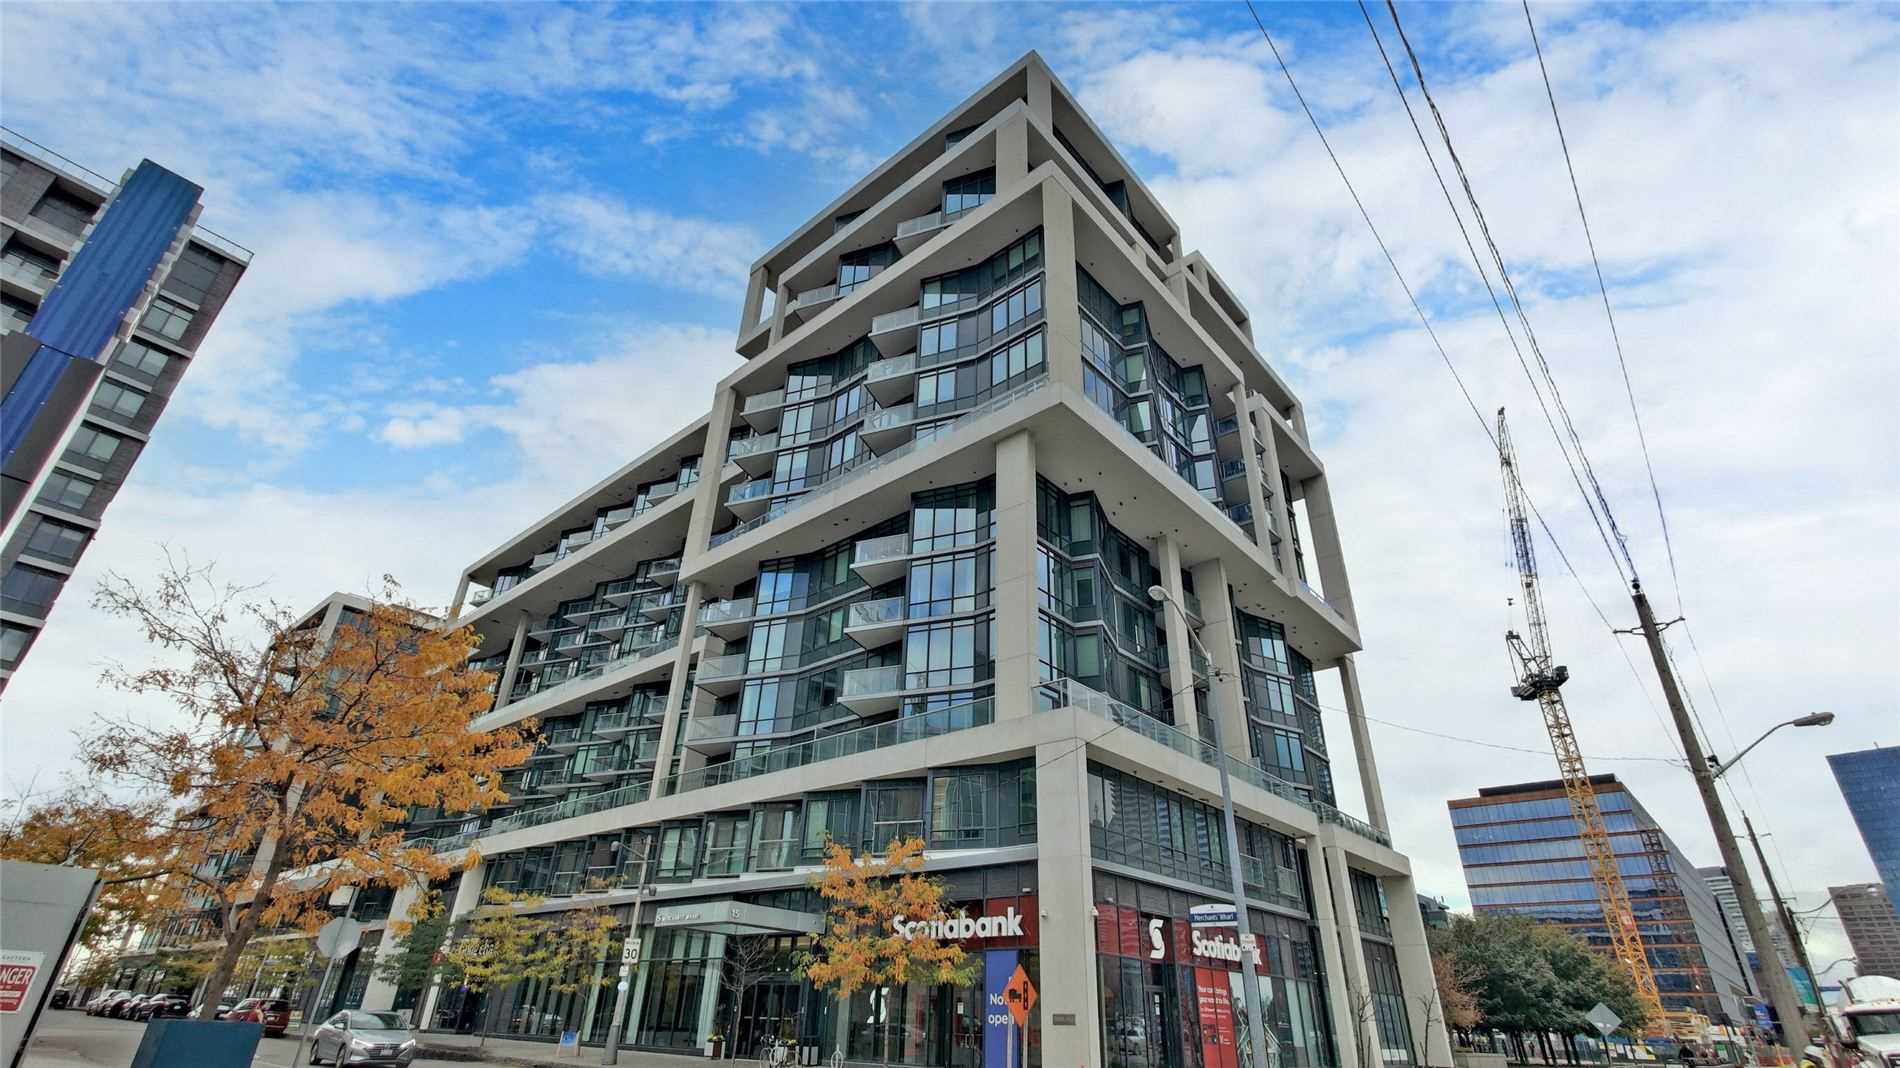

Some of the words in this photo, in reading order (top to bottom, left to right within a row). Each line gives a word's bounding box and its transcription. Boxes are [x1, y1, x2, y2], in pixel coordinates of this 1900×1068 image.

[624, 948, 638, 960] 30
[1192, 930, 1262, 965] Scotiabk
[0, 967, 34, 985] NGER
[989, 993, 1008, 1006] No
